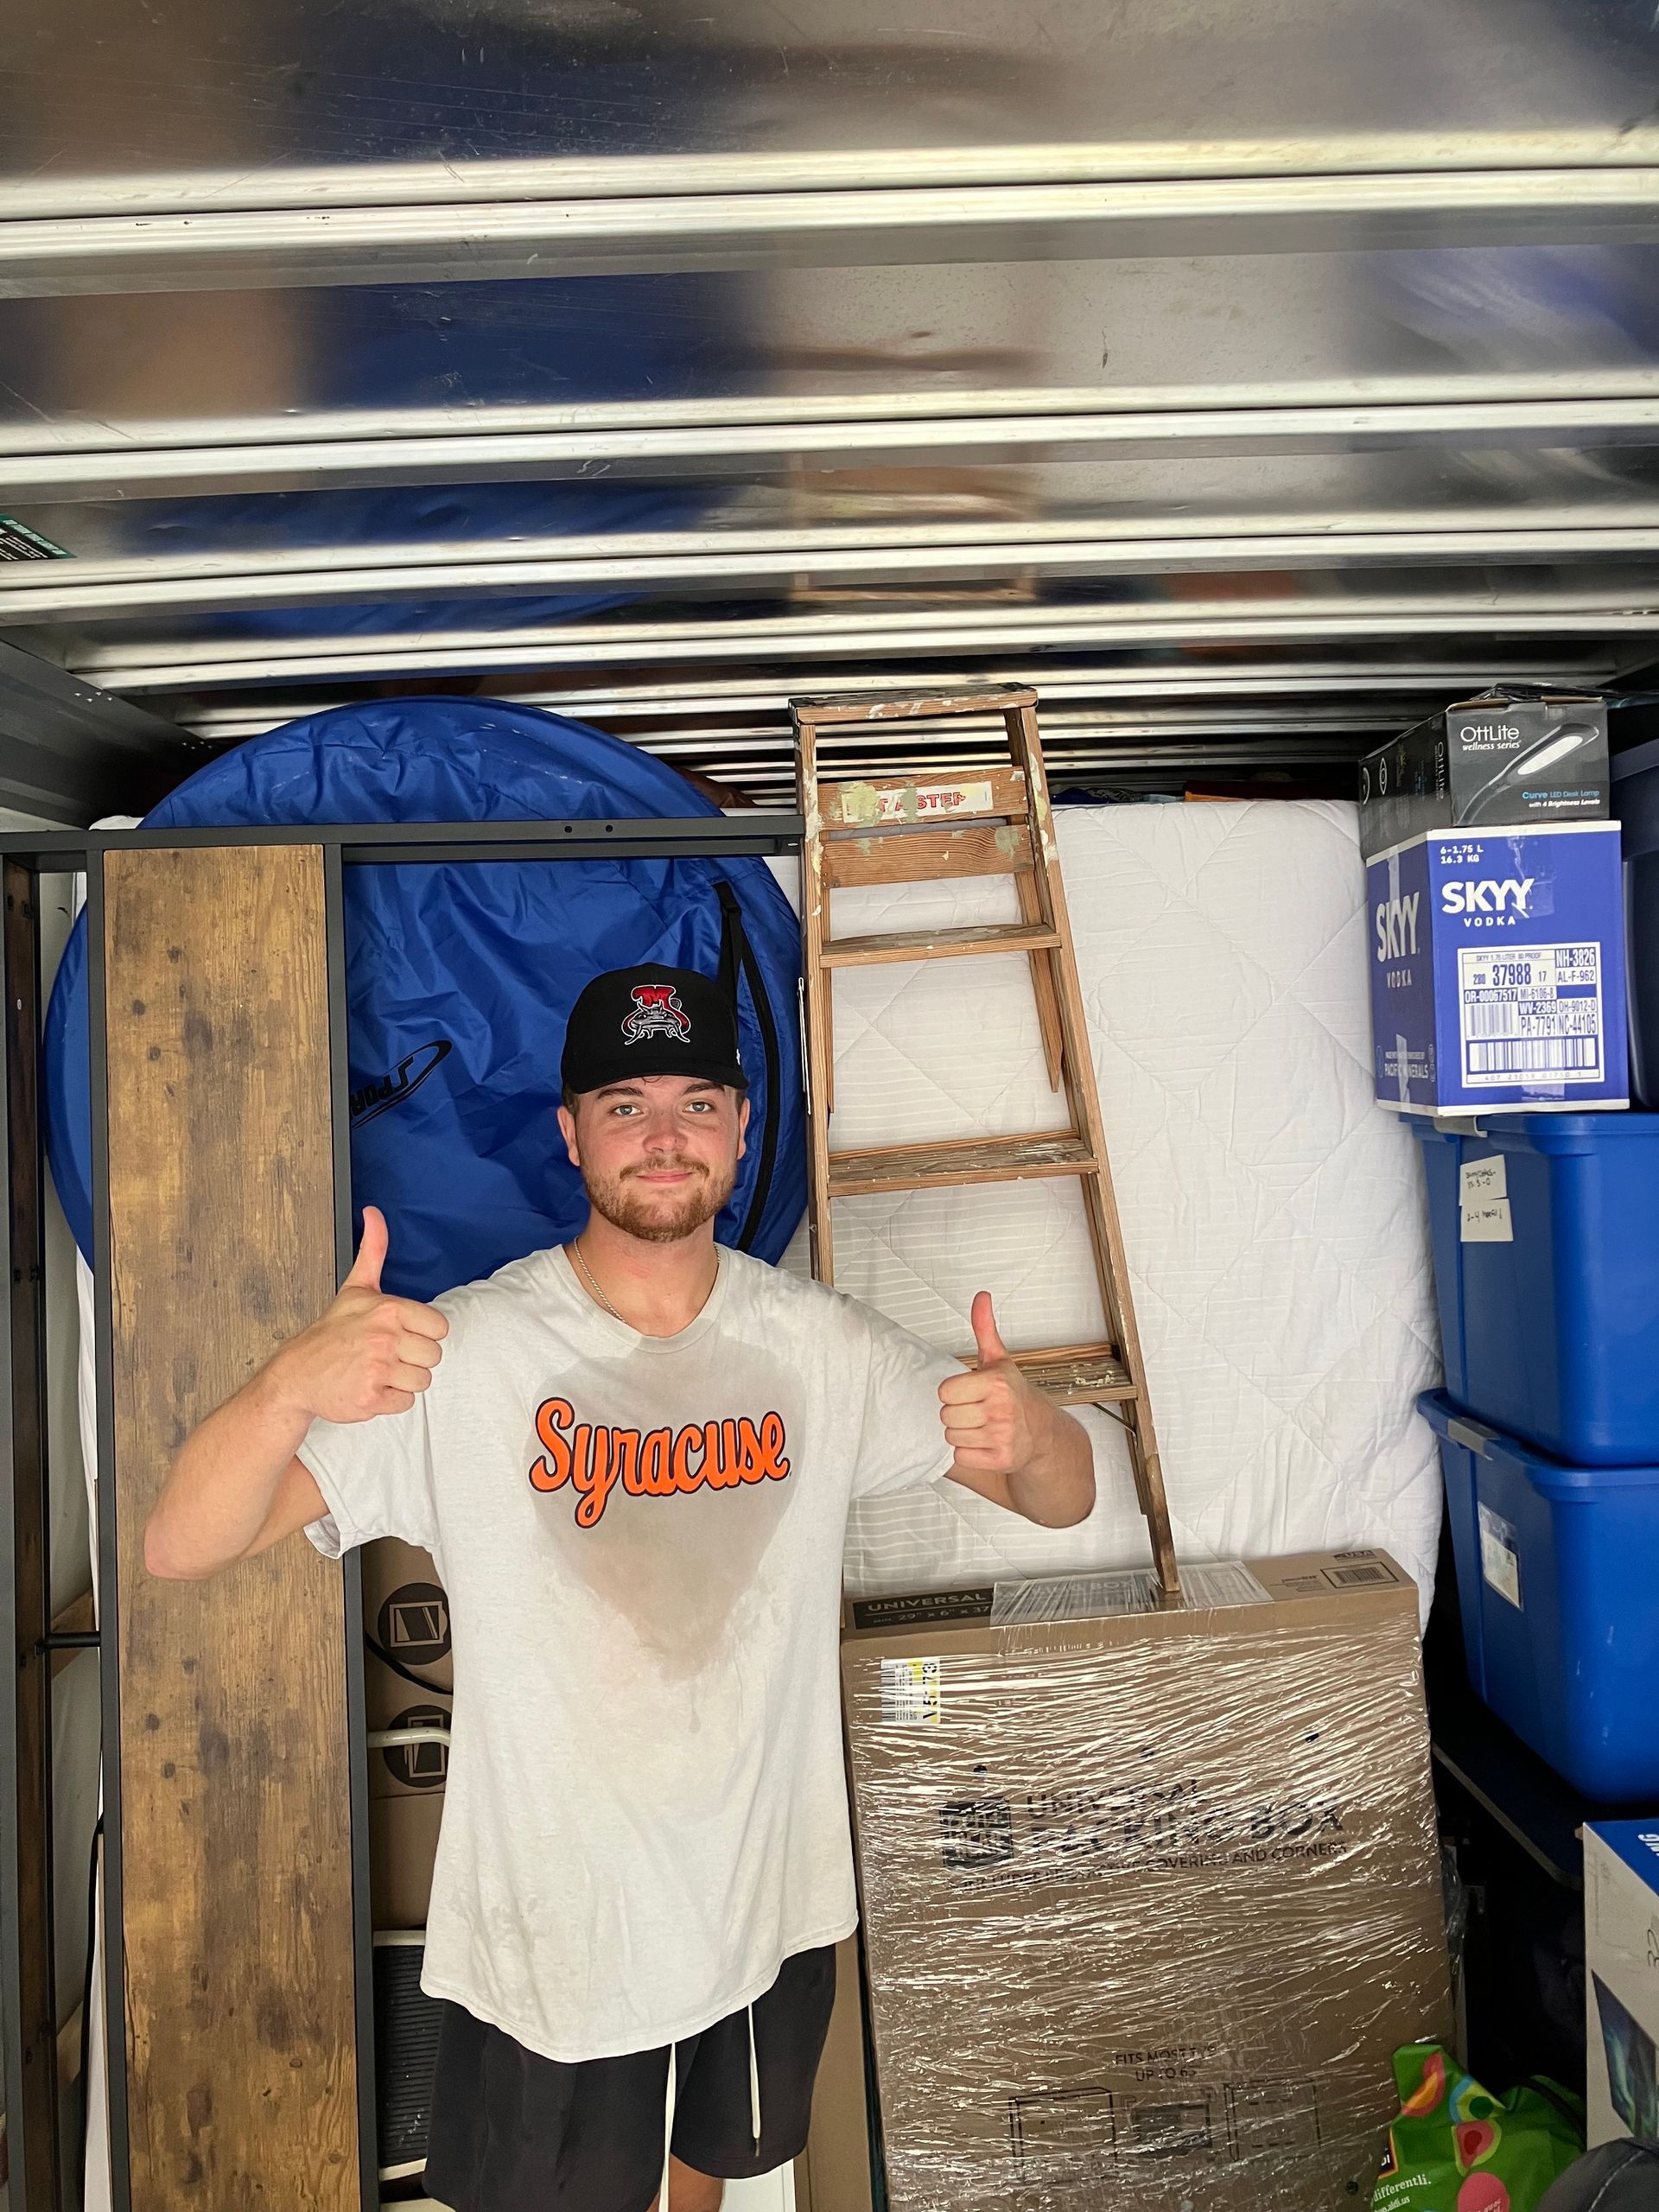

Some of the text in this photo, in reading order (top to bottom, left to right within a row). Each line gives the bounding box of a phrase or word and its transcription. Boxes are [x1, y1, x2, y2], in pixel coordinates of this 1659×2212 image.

[1460, 724, 1520, 742] OttLite
[1462, 741, 1495, 751] wellness
[1440, 844, 1484, 855] 6-1.75 L
[1440, 854, 1480, 864] 16.3 KG
[1441, 878, 1535, 914] SKYY
[1376, 891, 1420, 963] SKYY
[1463, 916, 1516, 927] VODKA
[1556, 947, 1596, 968] NH-3826
[1386, 969, 1413, 988] VODKA
[1492, 963, 1531, 987] 37988
[1538, 971, 1547, 982] 17
[1557, 969, 1595, 982] AL-F-962
[1521, 1014, 1596, 1037] PA-7791 NC-44105
[529, 1396, 791, 1529] Syracuse
[868, 1593, 987, 1611] UNIVERSAL
[1232, 1847, 1268, 1865] AND
[1116, 2052, 1143, 2065] FITS
[1135, 2069, 1154, 2082] UP
